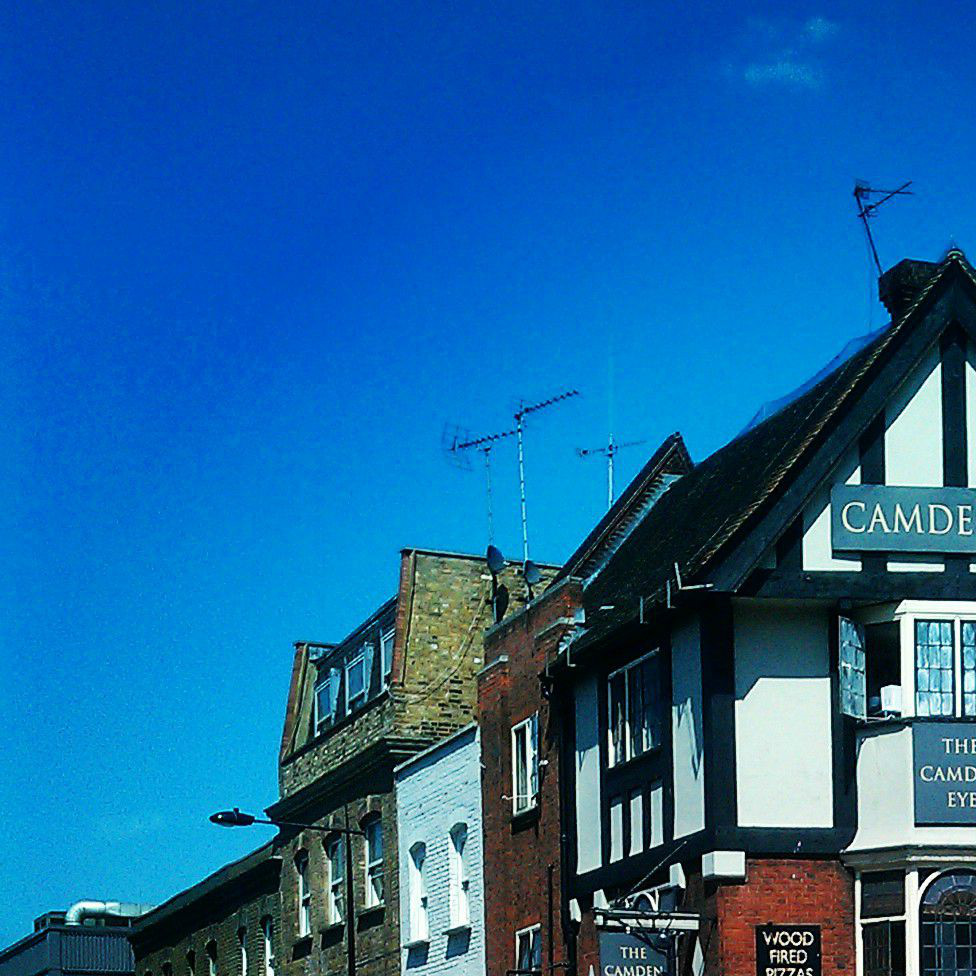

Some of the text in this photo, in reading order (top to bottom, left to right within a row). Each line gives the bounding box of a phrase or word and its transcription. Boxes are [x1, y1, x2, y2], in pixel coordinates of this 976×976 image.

[762, 931, 814, 946] WOOD
[620, 946, 647, 959] THE
[769, 950, 808, 964] FIRED
[604, 965, 664, 976] CAMDEN
